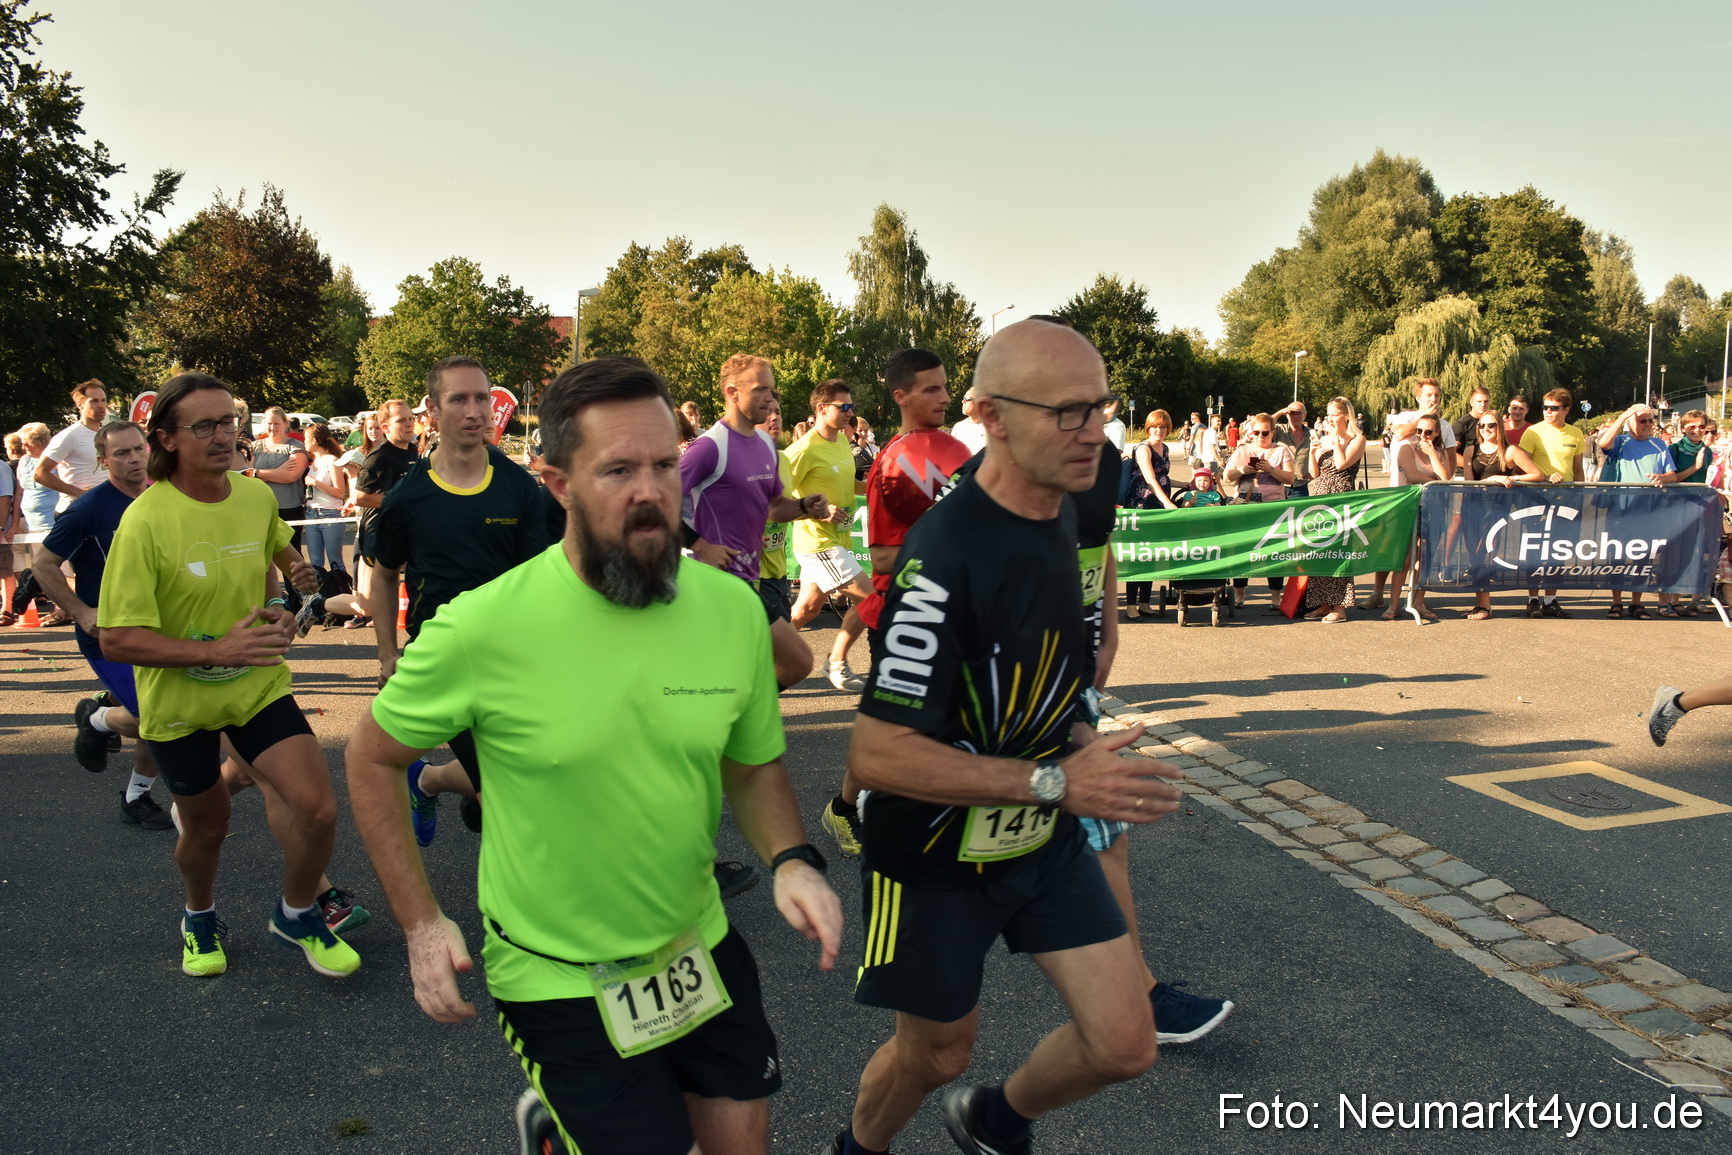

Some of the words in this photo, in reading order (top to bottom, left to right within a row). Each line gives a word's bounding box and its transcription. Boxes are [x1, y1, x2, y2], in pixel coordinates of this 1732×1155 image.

[1253, 504, 1374, 549] AOK
[1117, 540, 1222, 562] Händen
[1250, 552, 1267, 562] Die
[1519, 532, 1667, 561] Fischer
[1531, 565, 1653, 577] AUTOMOBILE
[876, 573, 949, 696] now
[617, 956, 702, 1020] 1163
[632, 1014, 670, 1033] Hiereth
